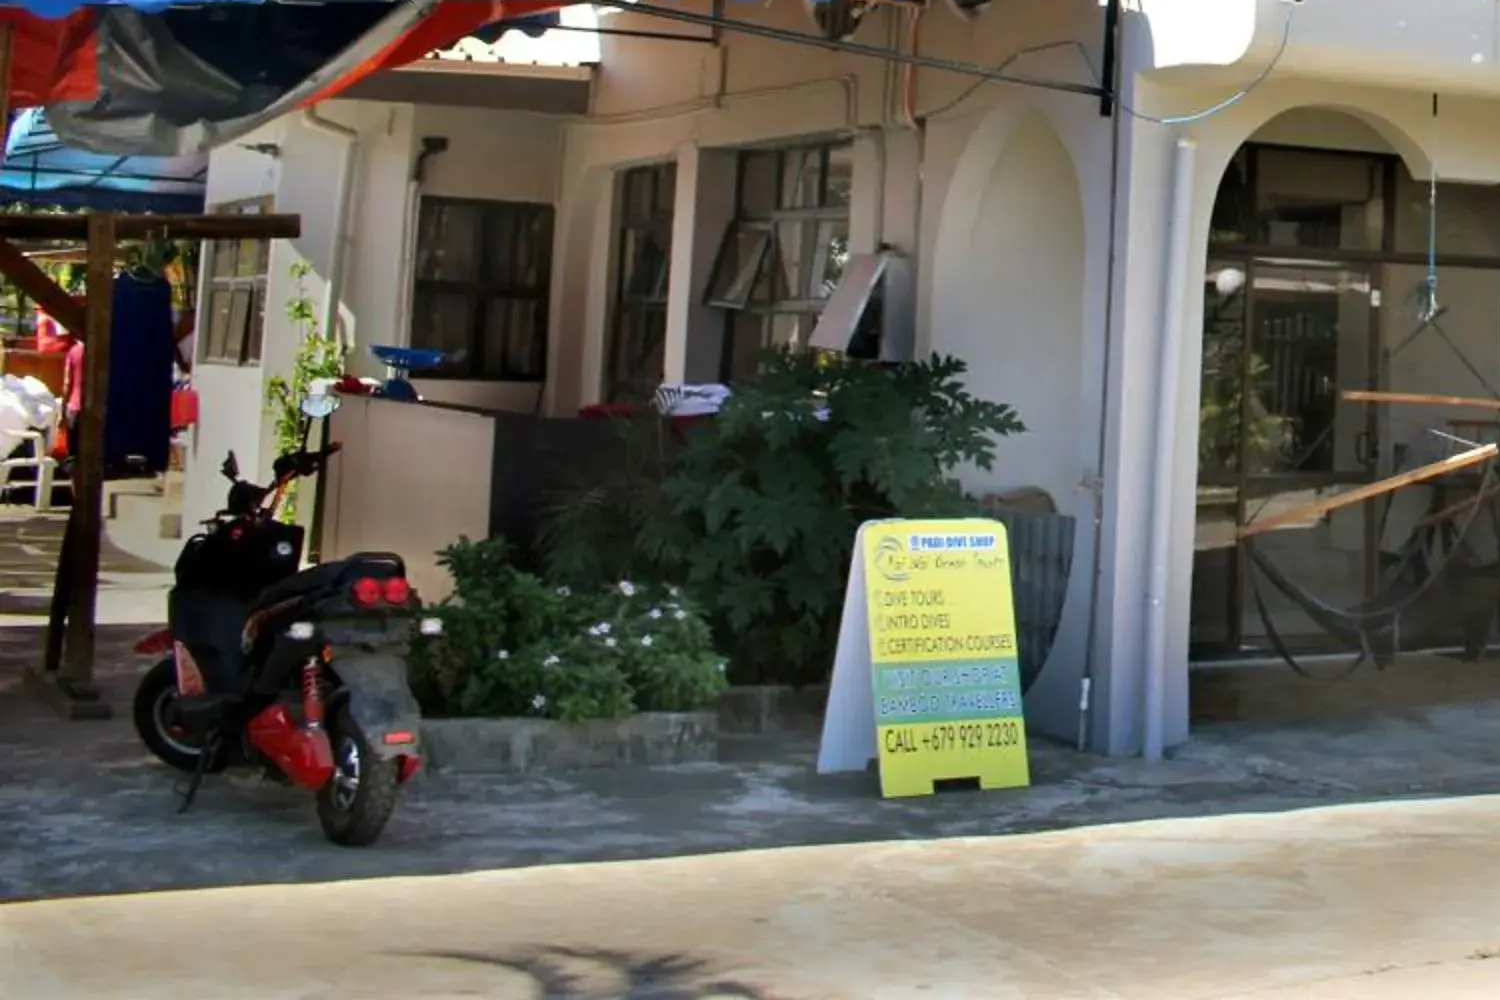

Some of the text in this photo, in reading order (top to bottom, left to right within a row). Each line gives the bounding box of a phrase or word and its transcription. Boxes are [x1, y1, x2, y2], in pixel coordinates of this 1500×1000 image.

[884, 589, 945, 607] DIVE TOURS
[887, 613, 950, 630] INTRO DIVES
[887, 633, 1013, 655] CERTIFICATION COURSES
[879, 693, 940, 715] BAMBOO
[885, 722, 1018, 753] CALL +679 929 2230
